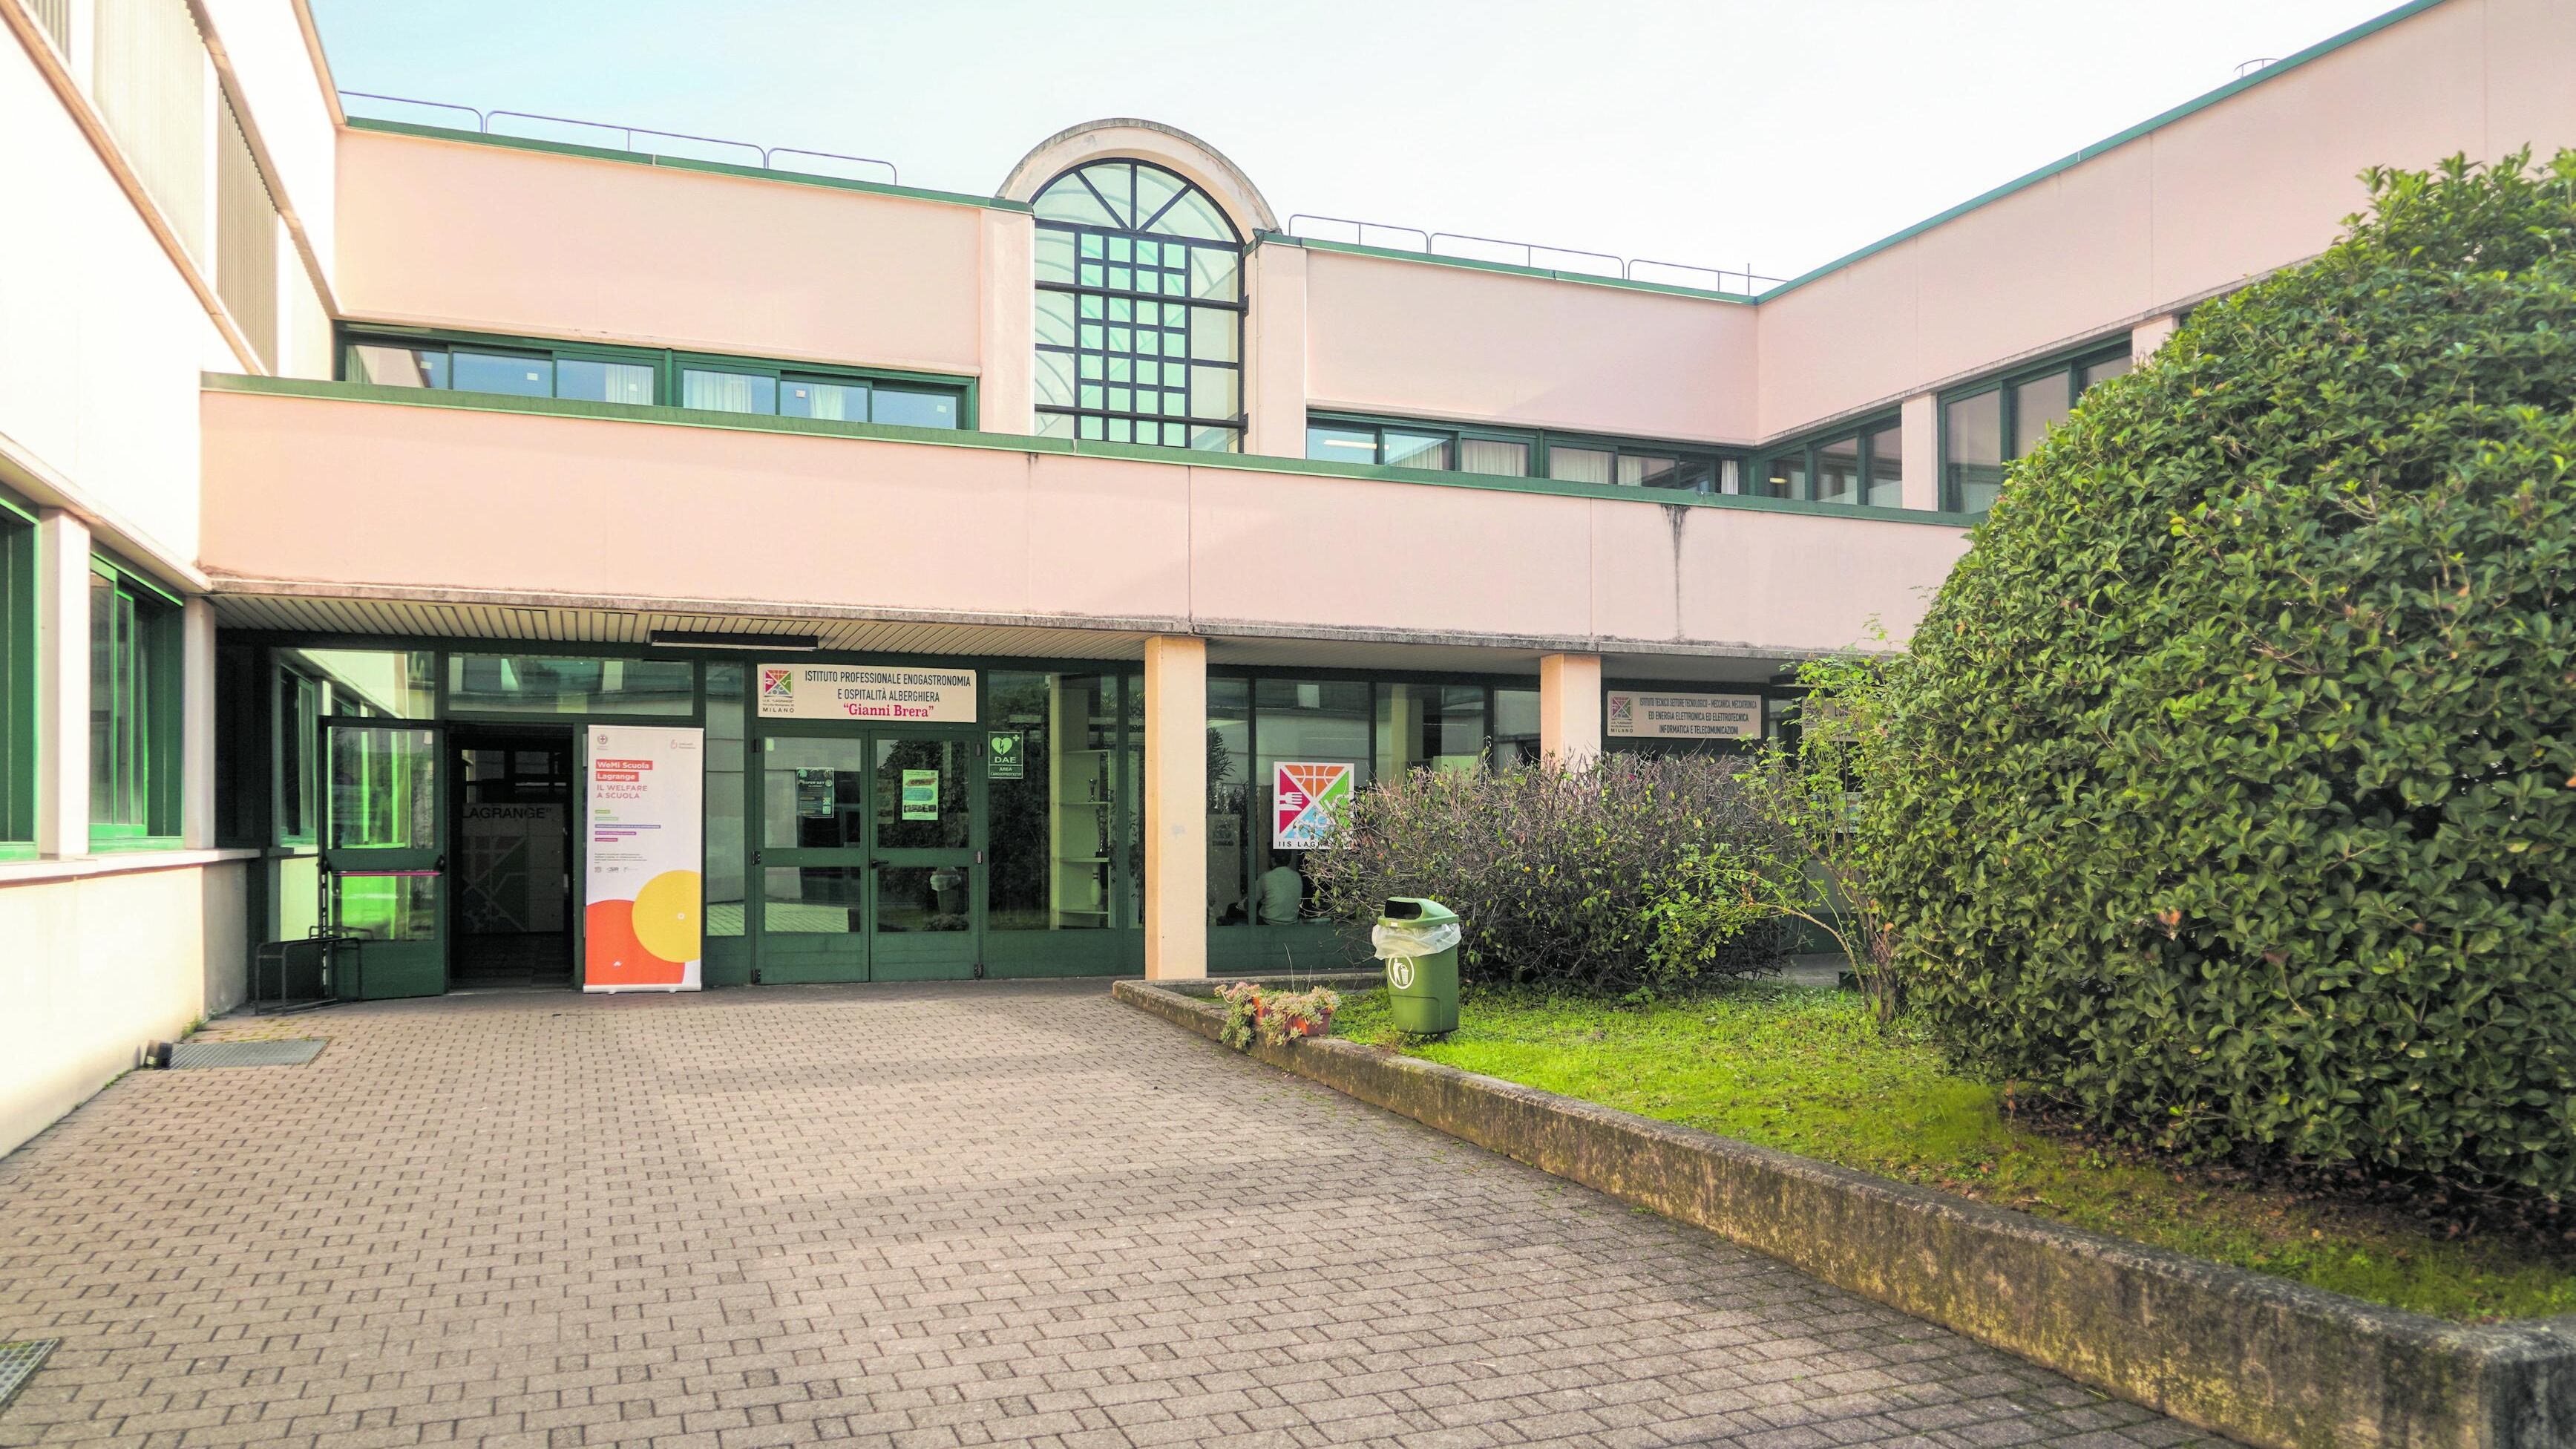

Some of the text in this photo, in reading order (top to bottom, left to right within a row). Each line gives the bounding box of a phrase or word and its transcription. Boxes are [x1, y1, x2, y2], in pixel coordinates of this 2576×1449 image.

[805, 670, 971, 687] ISTITUTO PROFESSIONALE ENOGASTRONOMIA
[837, 687, 940, 702] E OSPITALITÀ ALBERGHIERA
[1648, 711, 1749, 722] ED ENERGIA ELETTRONICA ED ELETTROTECNICA
[1659, 724, 1738, 735] INFORMATICA E TELECOMUNICAZIONI
[597, 772, 635, 780] Lagrange
